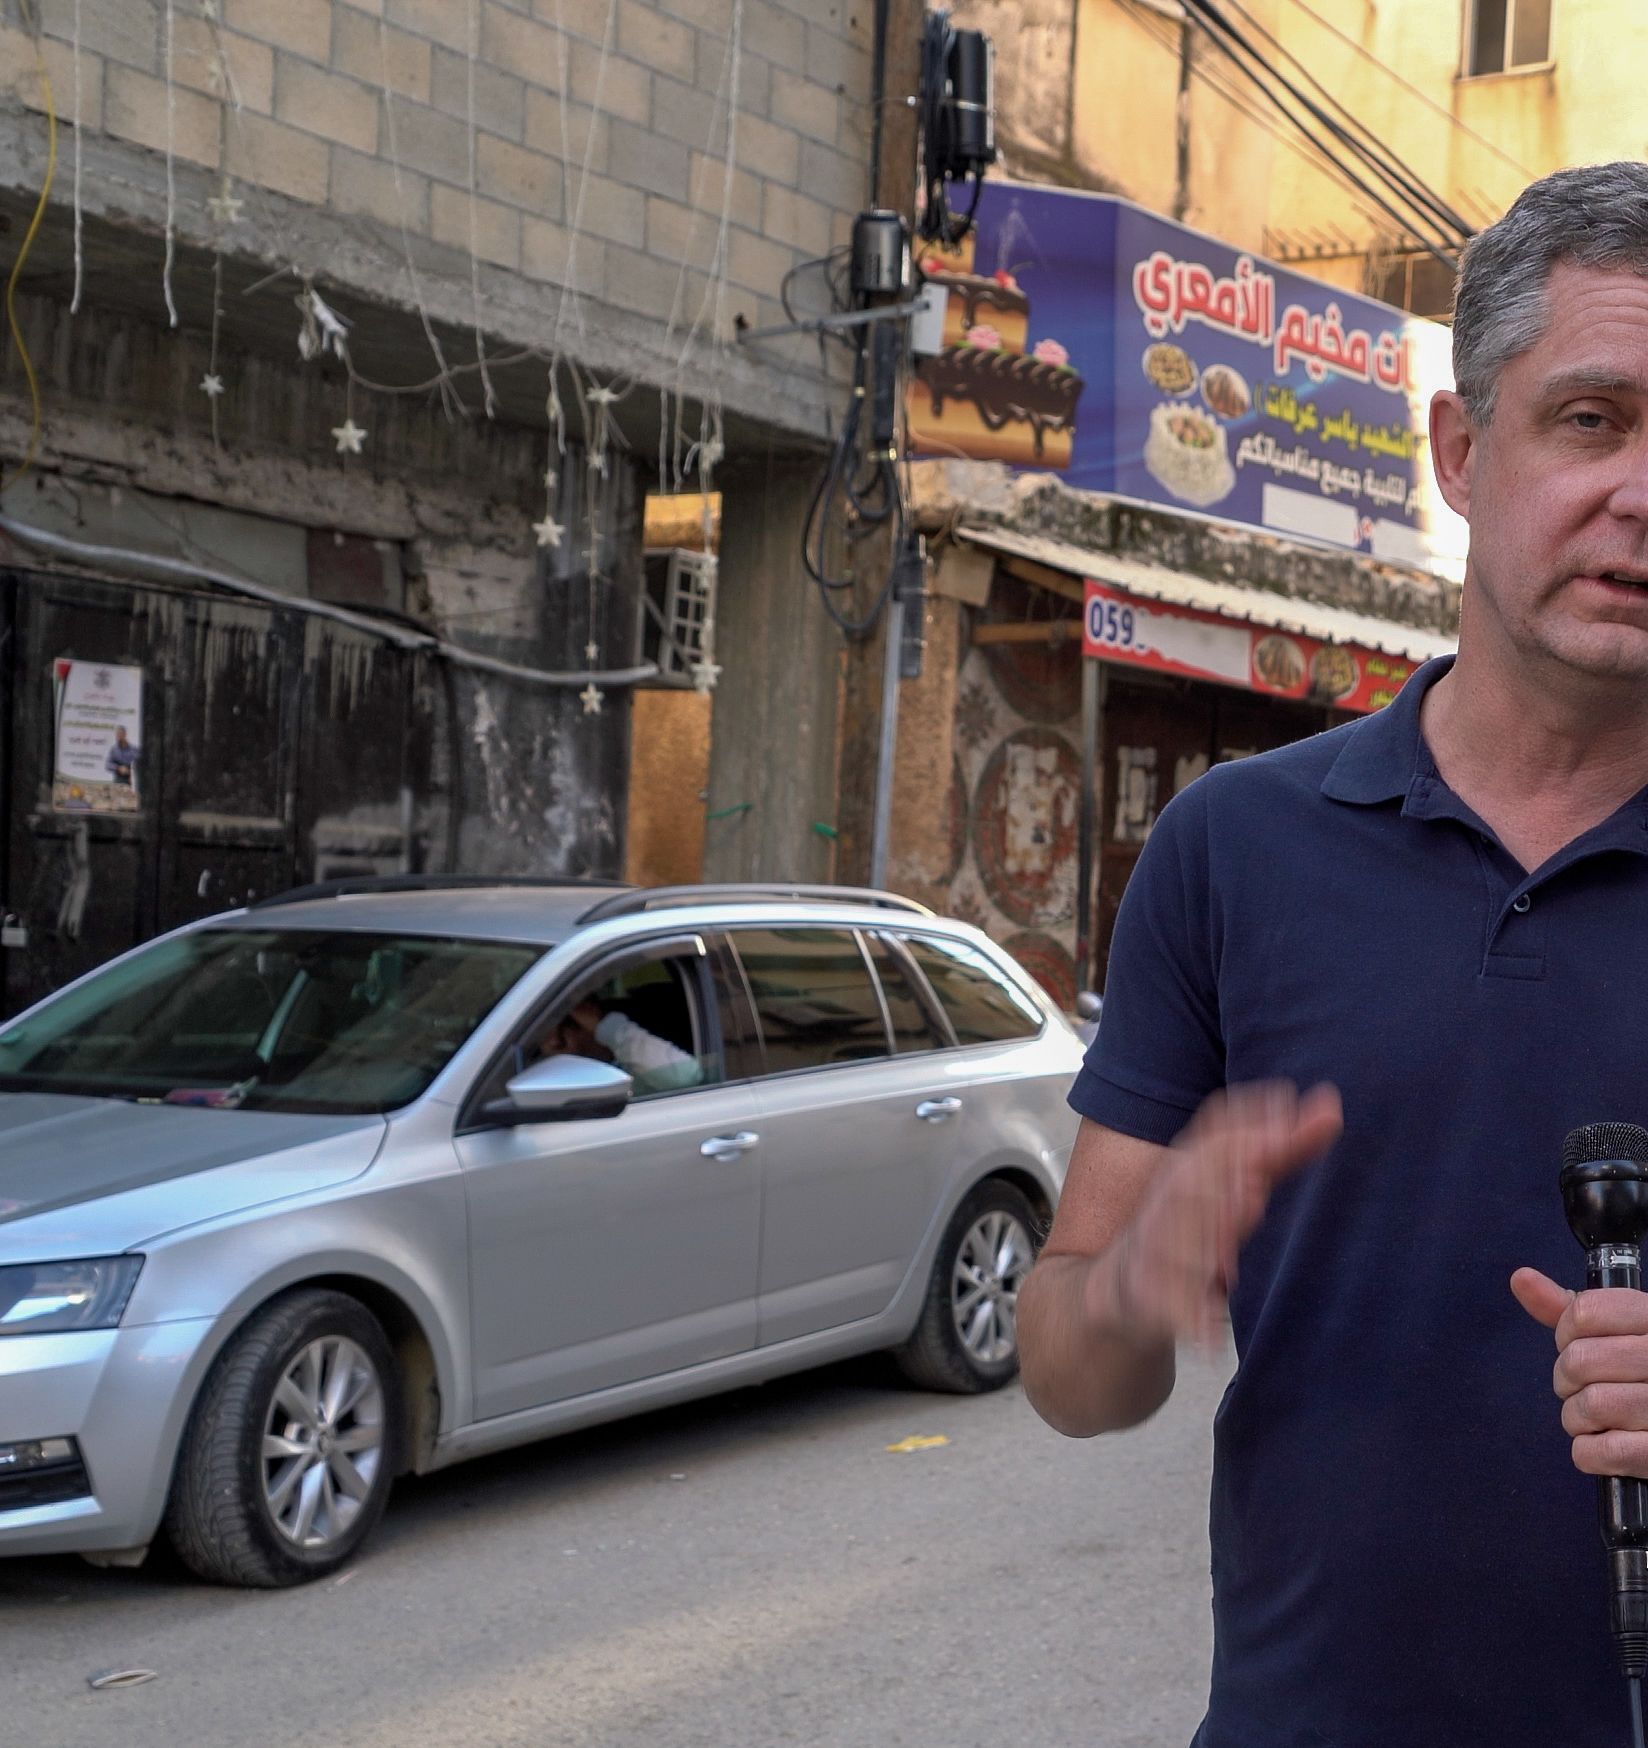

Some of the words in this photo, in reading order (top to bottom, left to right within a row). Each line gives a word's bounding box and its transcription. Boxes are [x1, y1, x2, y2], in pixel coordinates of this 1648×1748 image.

[1135, 253, 1273, 345] الأمعري
[1276, 304, 1370, 380] مخيم
[1320, 410, 1358, 449] ياسر
[1236, 432, 1320, 480] مناسباتكم
[1320, 460, 1361, 498] جميع
[1090, 599, 1147, 651] 059
